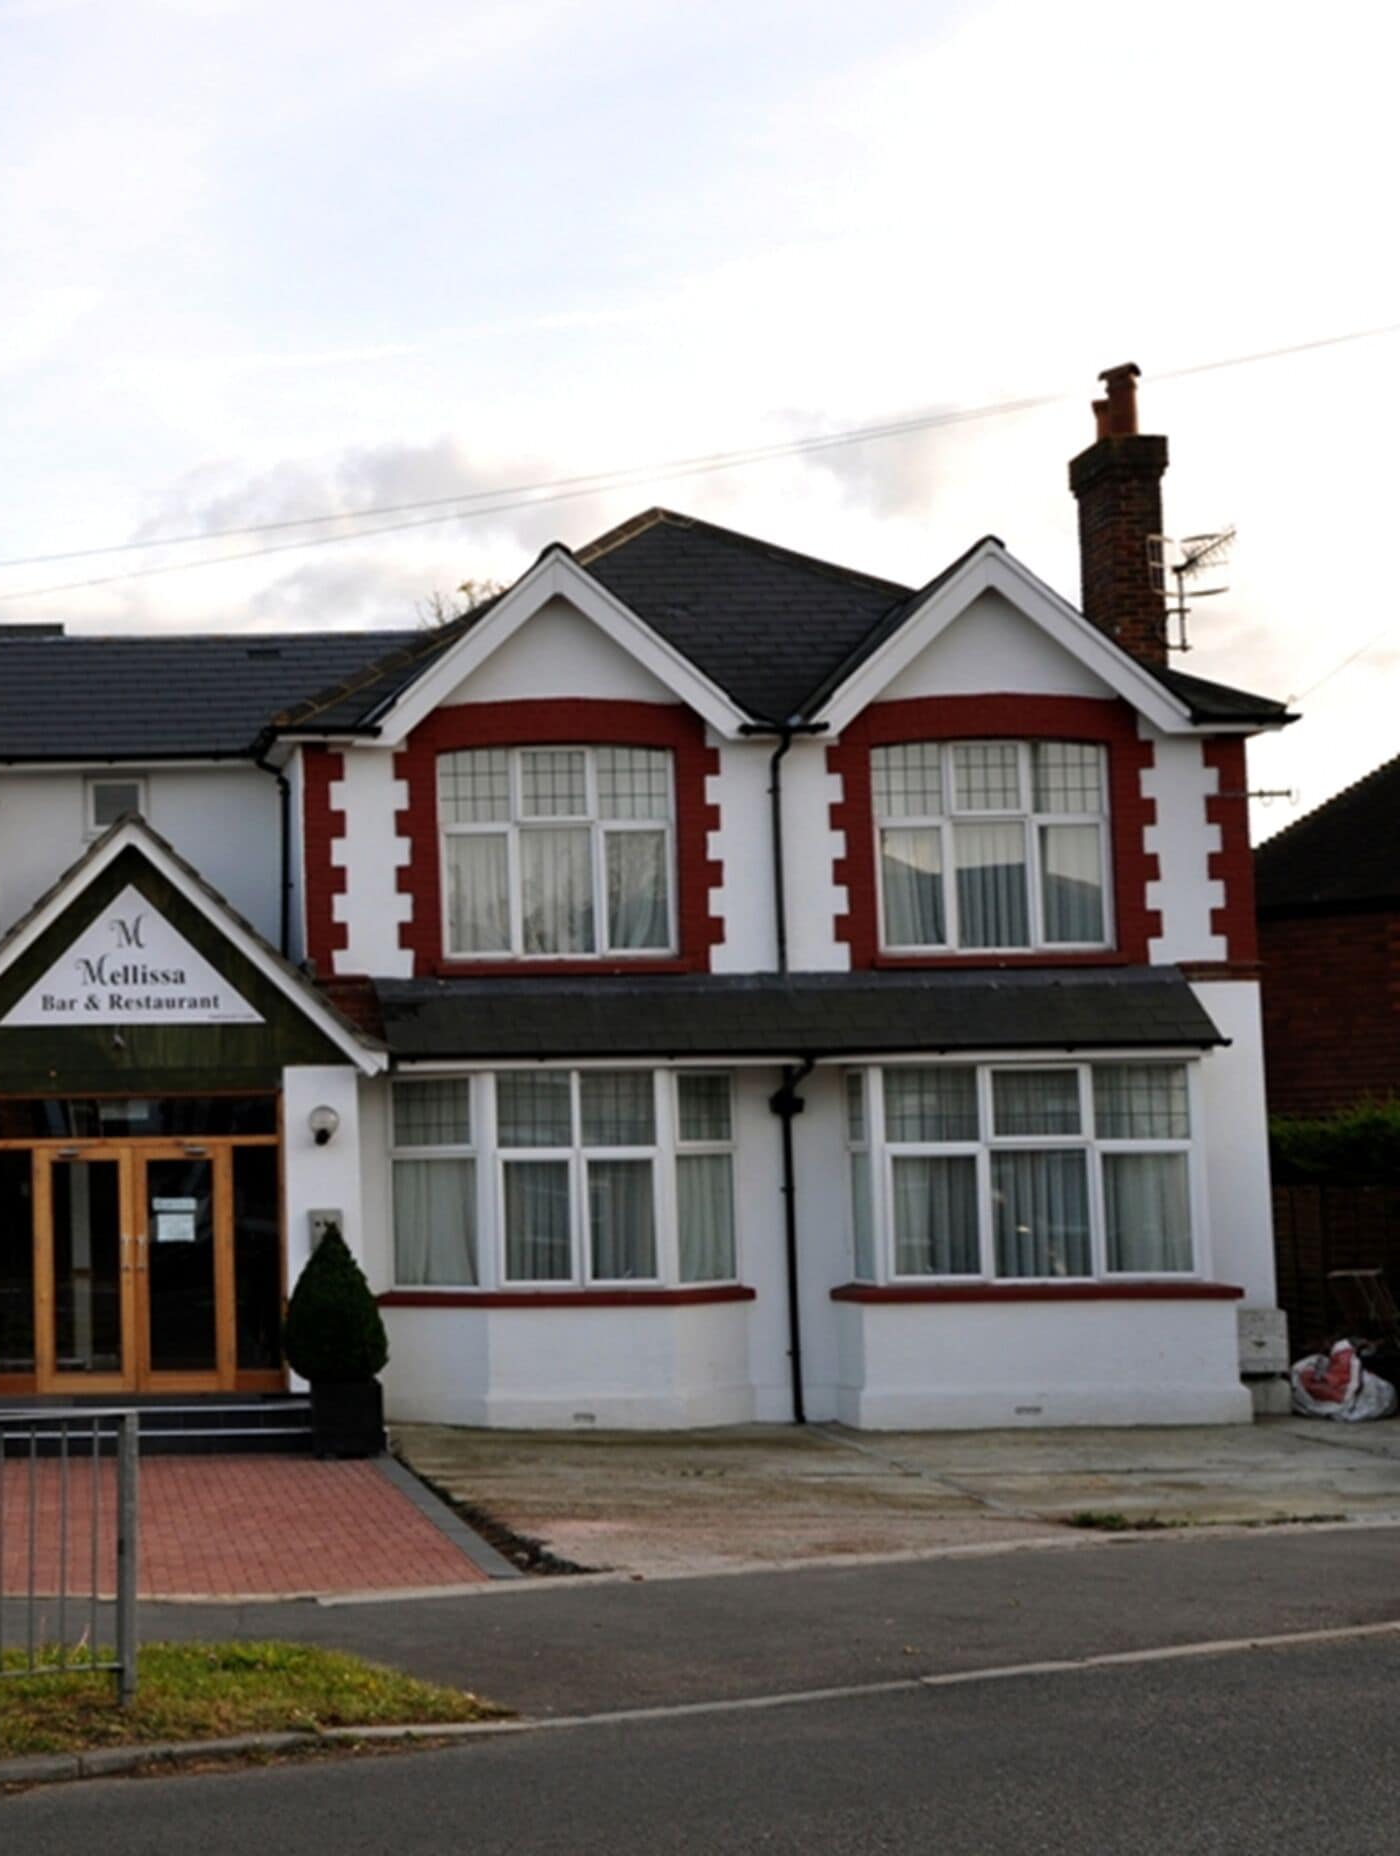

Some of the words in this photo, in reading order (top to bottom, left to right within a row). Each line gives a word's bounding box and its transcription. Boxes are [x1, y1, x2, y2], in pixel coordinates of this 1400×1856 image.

[110, 914, 147, 949] M
[76, 955, 186, 986] Mellissa
[41, 995, 78, 1011] Bar
[84, 994, 100, 1010] &
[108, 993, 220, 1010] Restaurant
